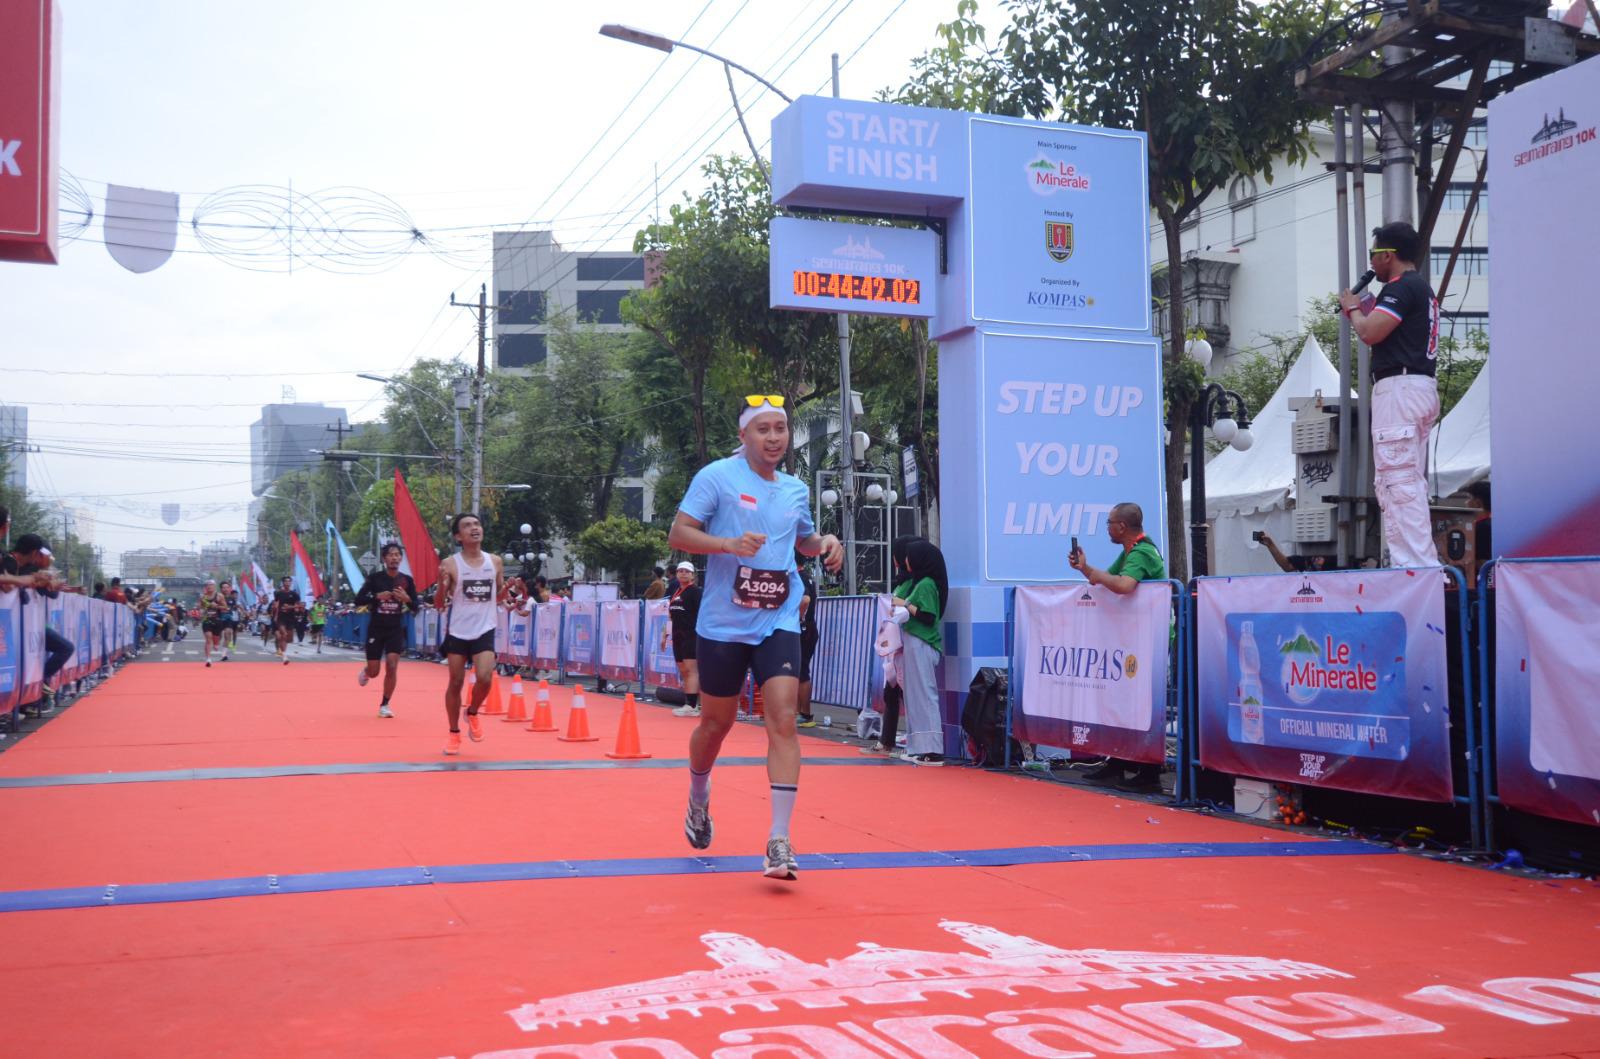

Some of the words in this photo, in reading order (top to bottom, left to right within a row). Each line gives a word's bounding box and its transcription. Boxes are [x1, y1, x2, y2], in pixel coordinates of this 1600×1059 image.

[826, 110, 940, 149] START/
[1037, 140, 1053, 148] Main
[1053, 142, 1077, 151] Sponsor
[1514, 135, 1574, 168] semarang
[1576, 127, 1596, 145] 10K
[827, 144, 938, 182] FINISH
[1060, 161, 1074, 176] Le
[1036, 171, 1089, 189] Minerale
[1044, 209, 1065, 217] Hosted
[1066, 211, 1074, 219] By
[793, 270, 918, 304] 00:44:42.02
[1040, 277, 1071, 286] Organized
[1072, 279, 1080, 287] By
[1027, 291, 1086, 308] KOMPAS
[996, 380, 1087, 415] STEP
[1094, 385, 1144, 417] UP
[1015, 442, 1120, 477] YOUR
[1003, 502, 1115, 536] LIMIT
[740, 580, 785, 594] A3094
[1327, 635, 1349, 665] Le
[1039, 645, 1123, 682] KOMPAS
[1290, 661, 1377, 691] Minerale
[1280, 718, 1315, 737] OFFICIAL
[1316, 721, 1355, 741] MINERAL
[1357, 724, 1388, 744] WATER
[1300, 753, 1316, 762] STEP
[1316, 755, 1326, 763] UP
[1303, 761, 1321, 769] YOUR
[1300, 768, 1324, 778] LIMIT
